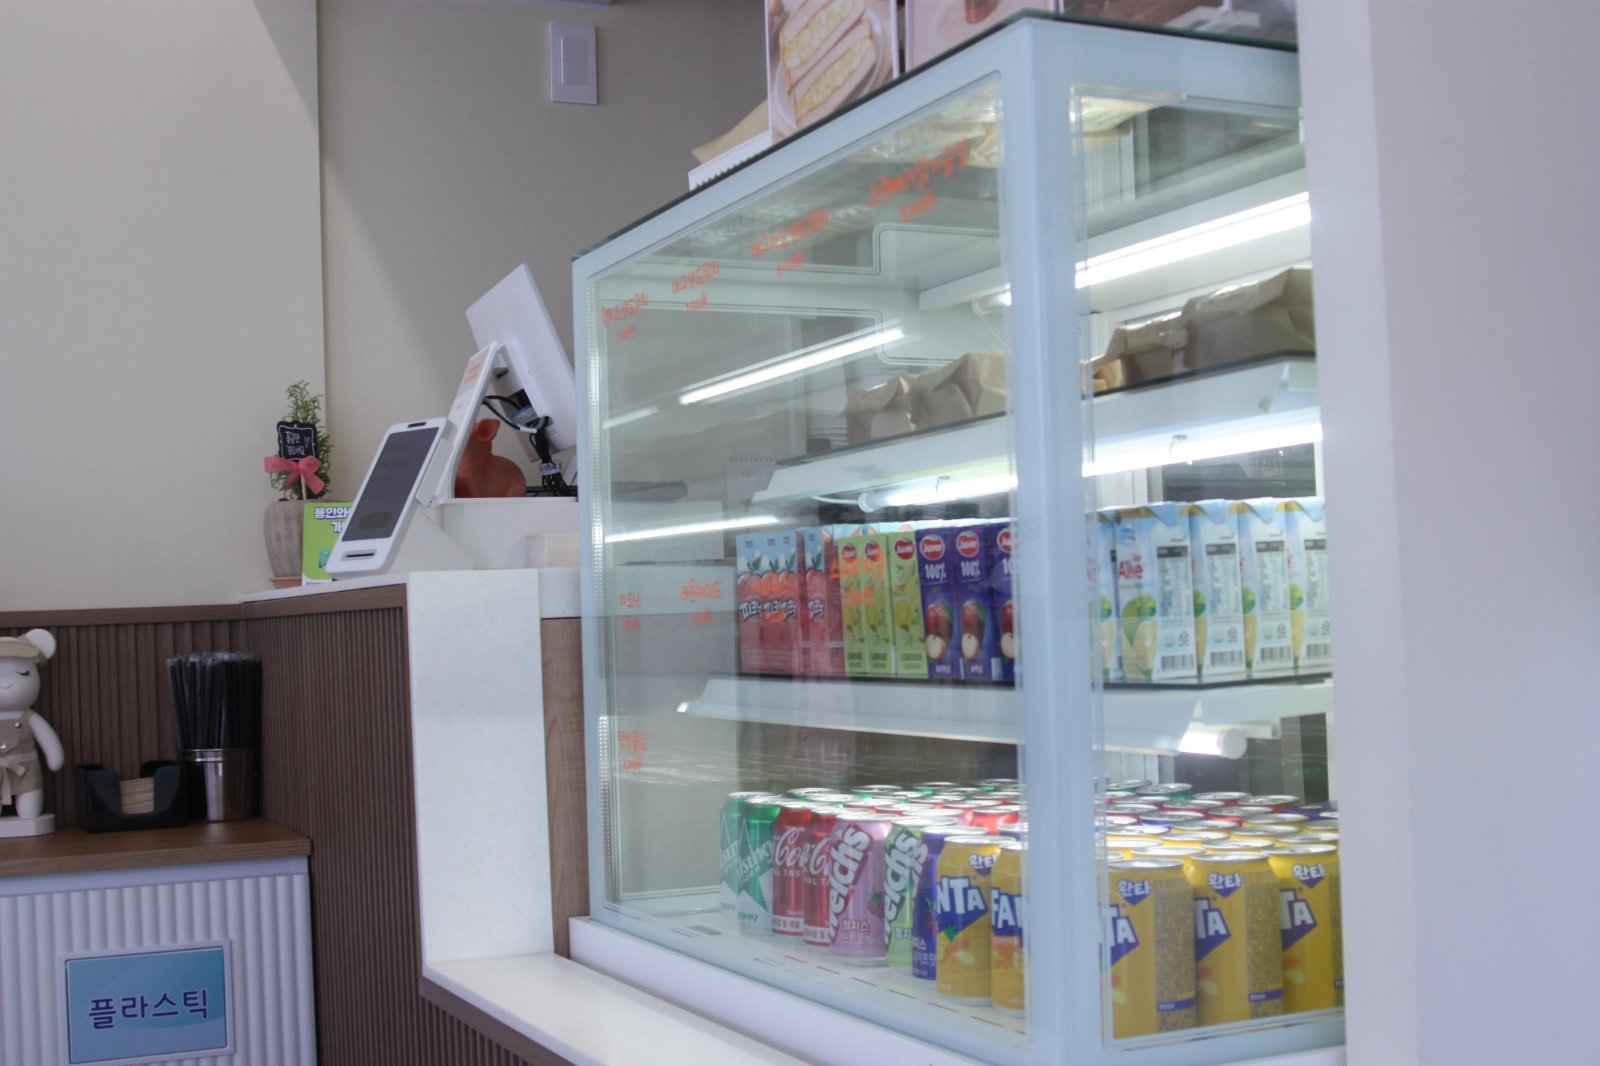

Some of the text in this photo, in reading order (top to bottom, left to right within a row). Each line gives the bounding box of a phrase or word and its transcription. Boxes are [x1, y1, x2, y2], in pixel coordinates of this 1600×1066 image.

[315, 507, 353, 520] 용인와
[925, 562, 947, 581] 100%
[937, 878, 985, 914] NTA
[89, 990, 207, 1029] 플라스틱
